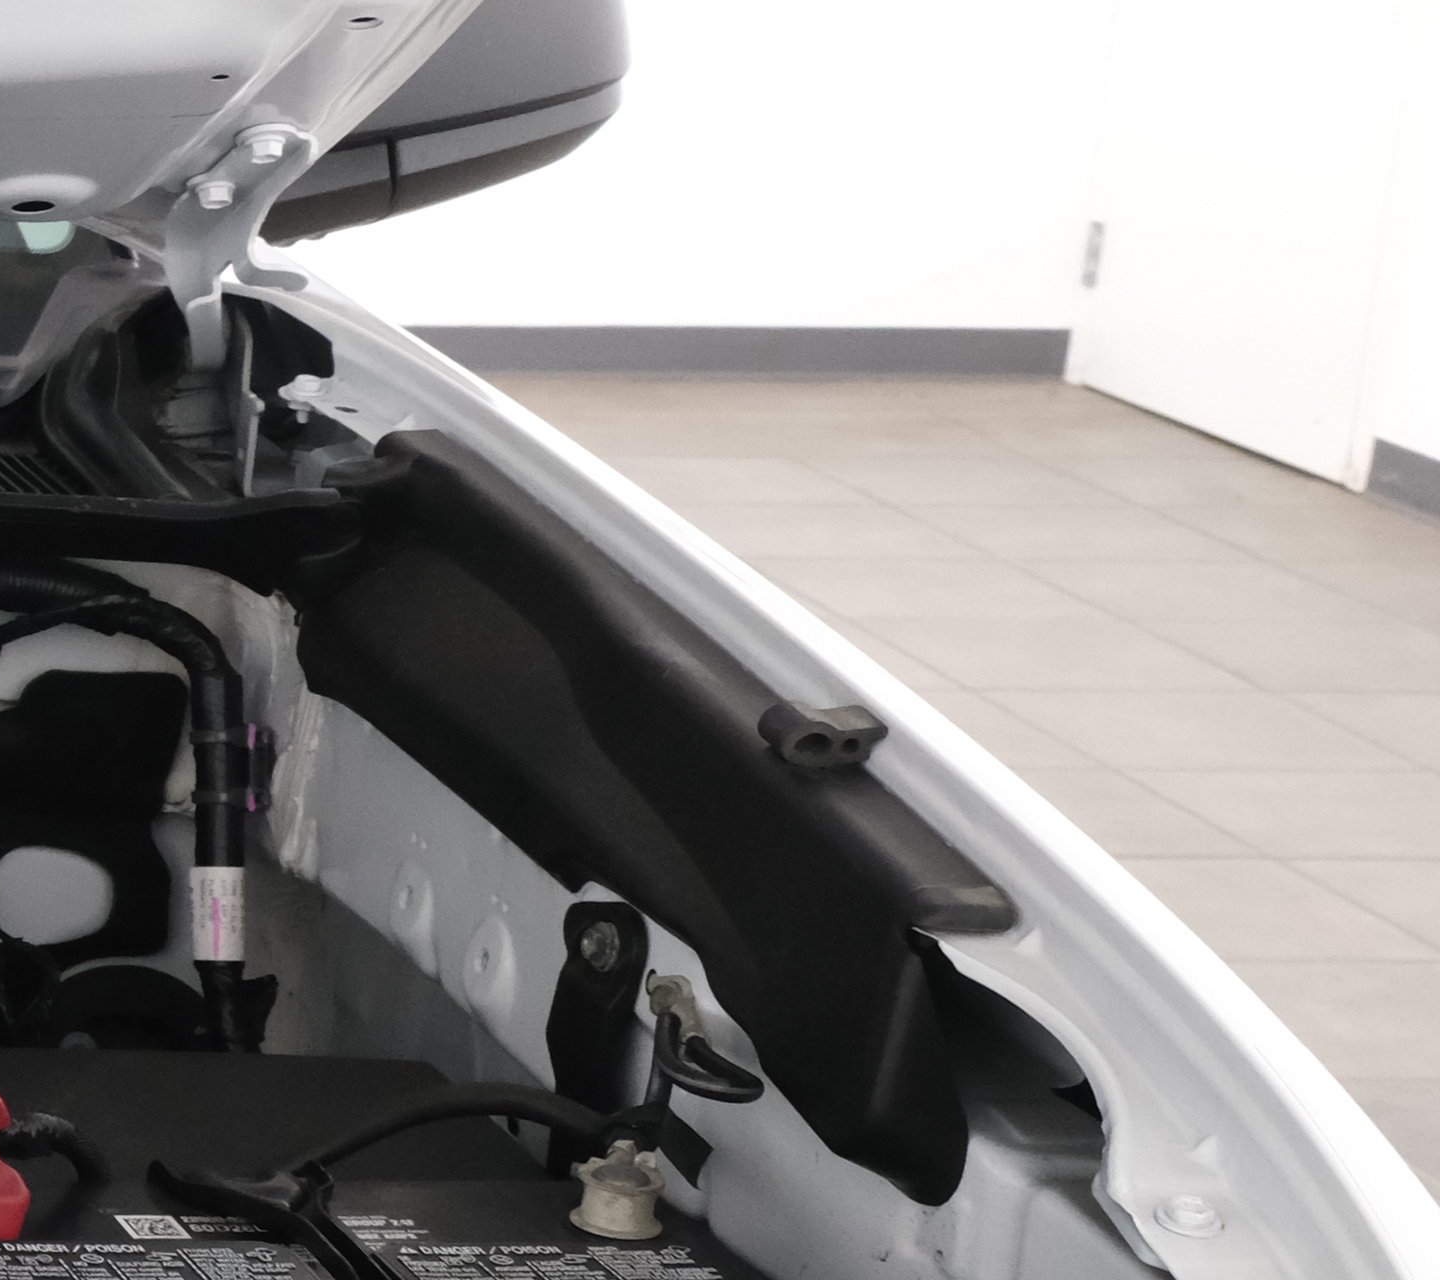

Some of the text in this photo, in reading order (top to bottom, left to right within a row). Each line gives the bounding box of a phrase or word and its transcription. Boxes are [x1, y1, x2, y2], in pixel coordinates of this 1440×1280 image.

[2, 1242, 70, 1253] DANGER
[83, 1243, 146, 1253] POISON
[418, 1245, 487, 1255] DANGER
[499, 1245, 563, 1254] POISON
